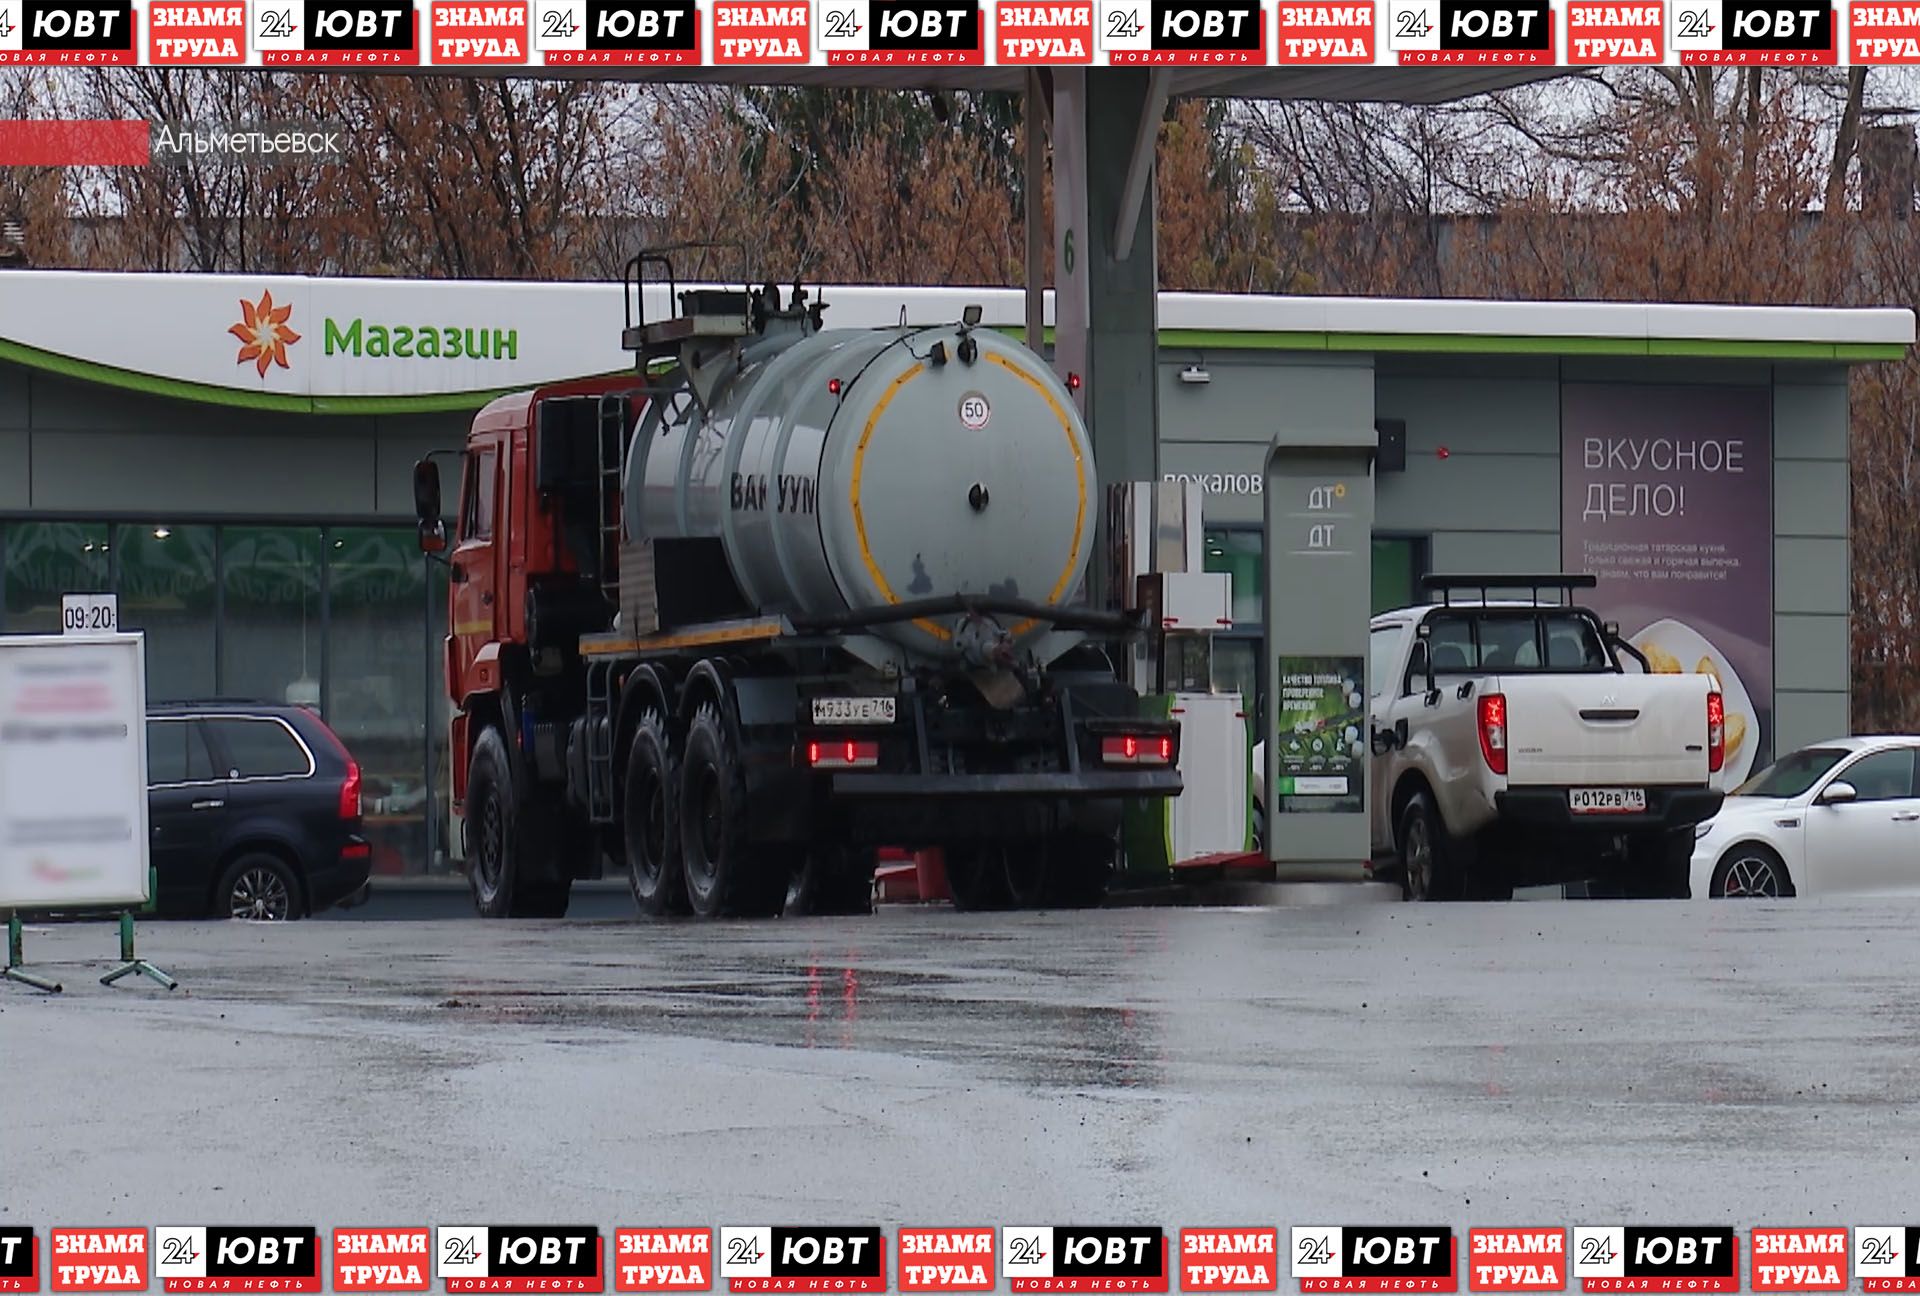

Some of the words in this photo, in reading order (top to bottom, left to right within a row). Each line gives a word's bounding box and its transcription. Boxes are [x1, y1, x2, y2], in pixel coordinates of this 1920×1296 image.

[1064, 228, 1074, 275] 6
[324, 317, 518, 360] Магазин
[965, 402, 984, 418] 50
[1583, 438, 1744, 473] ВКУСНОЕ
[1308, 486, 1334, 509] ДТ
[1583, 484, 1685, 522] ДЕЛО!
[1308, 524, 1335, 547] ДТ
